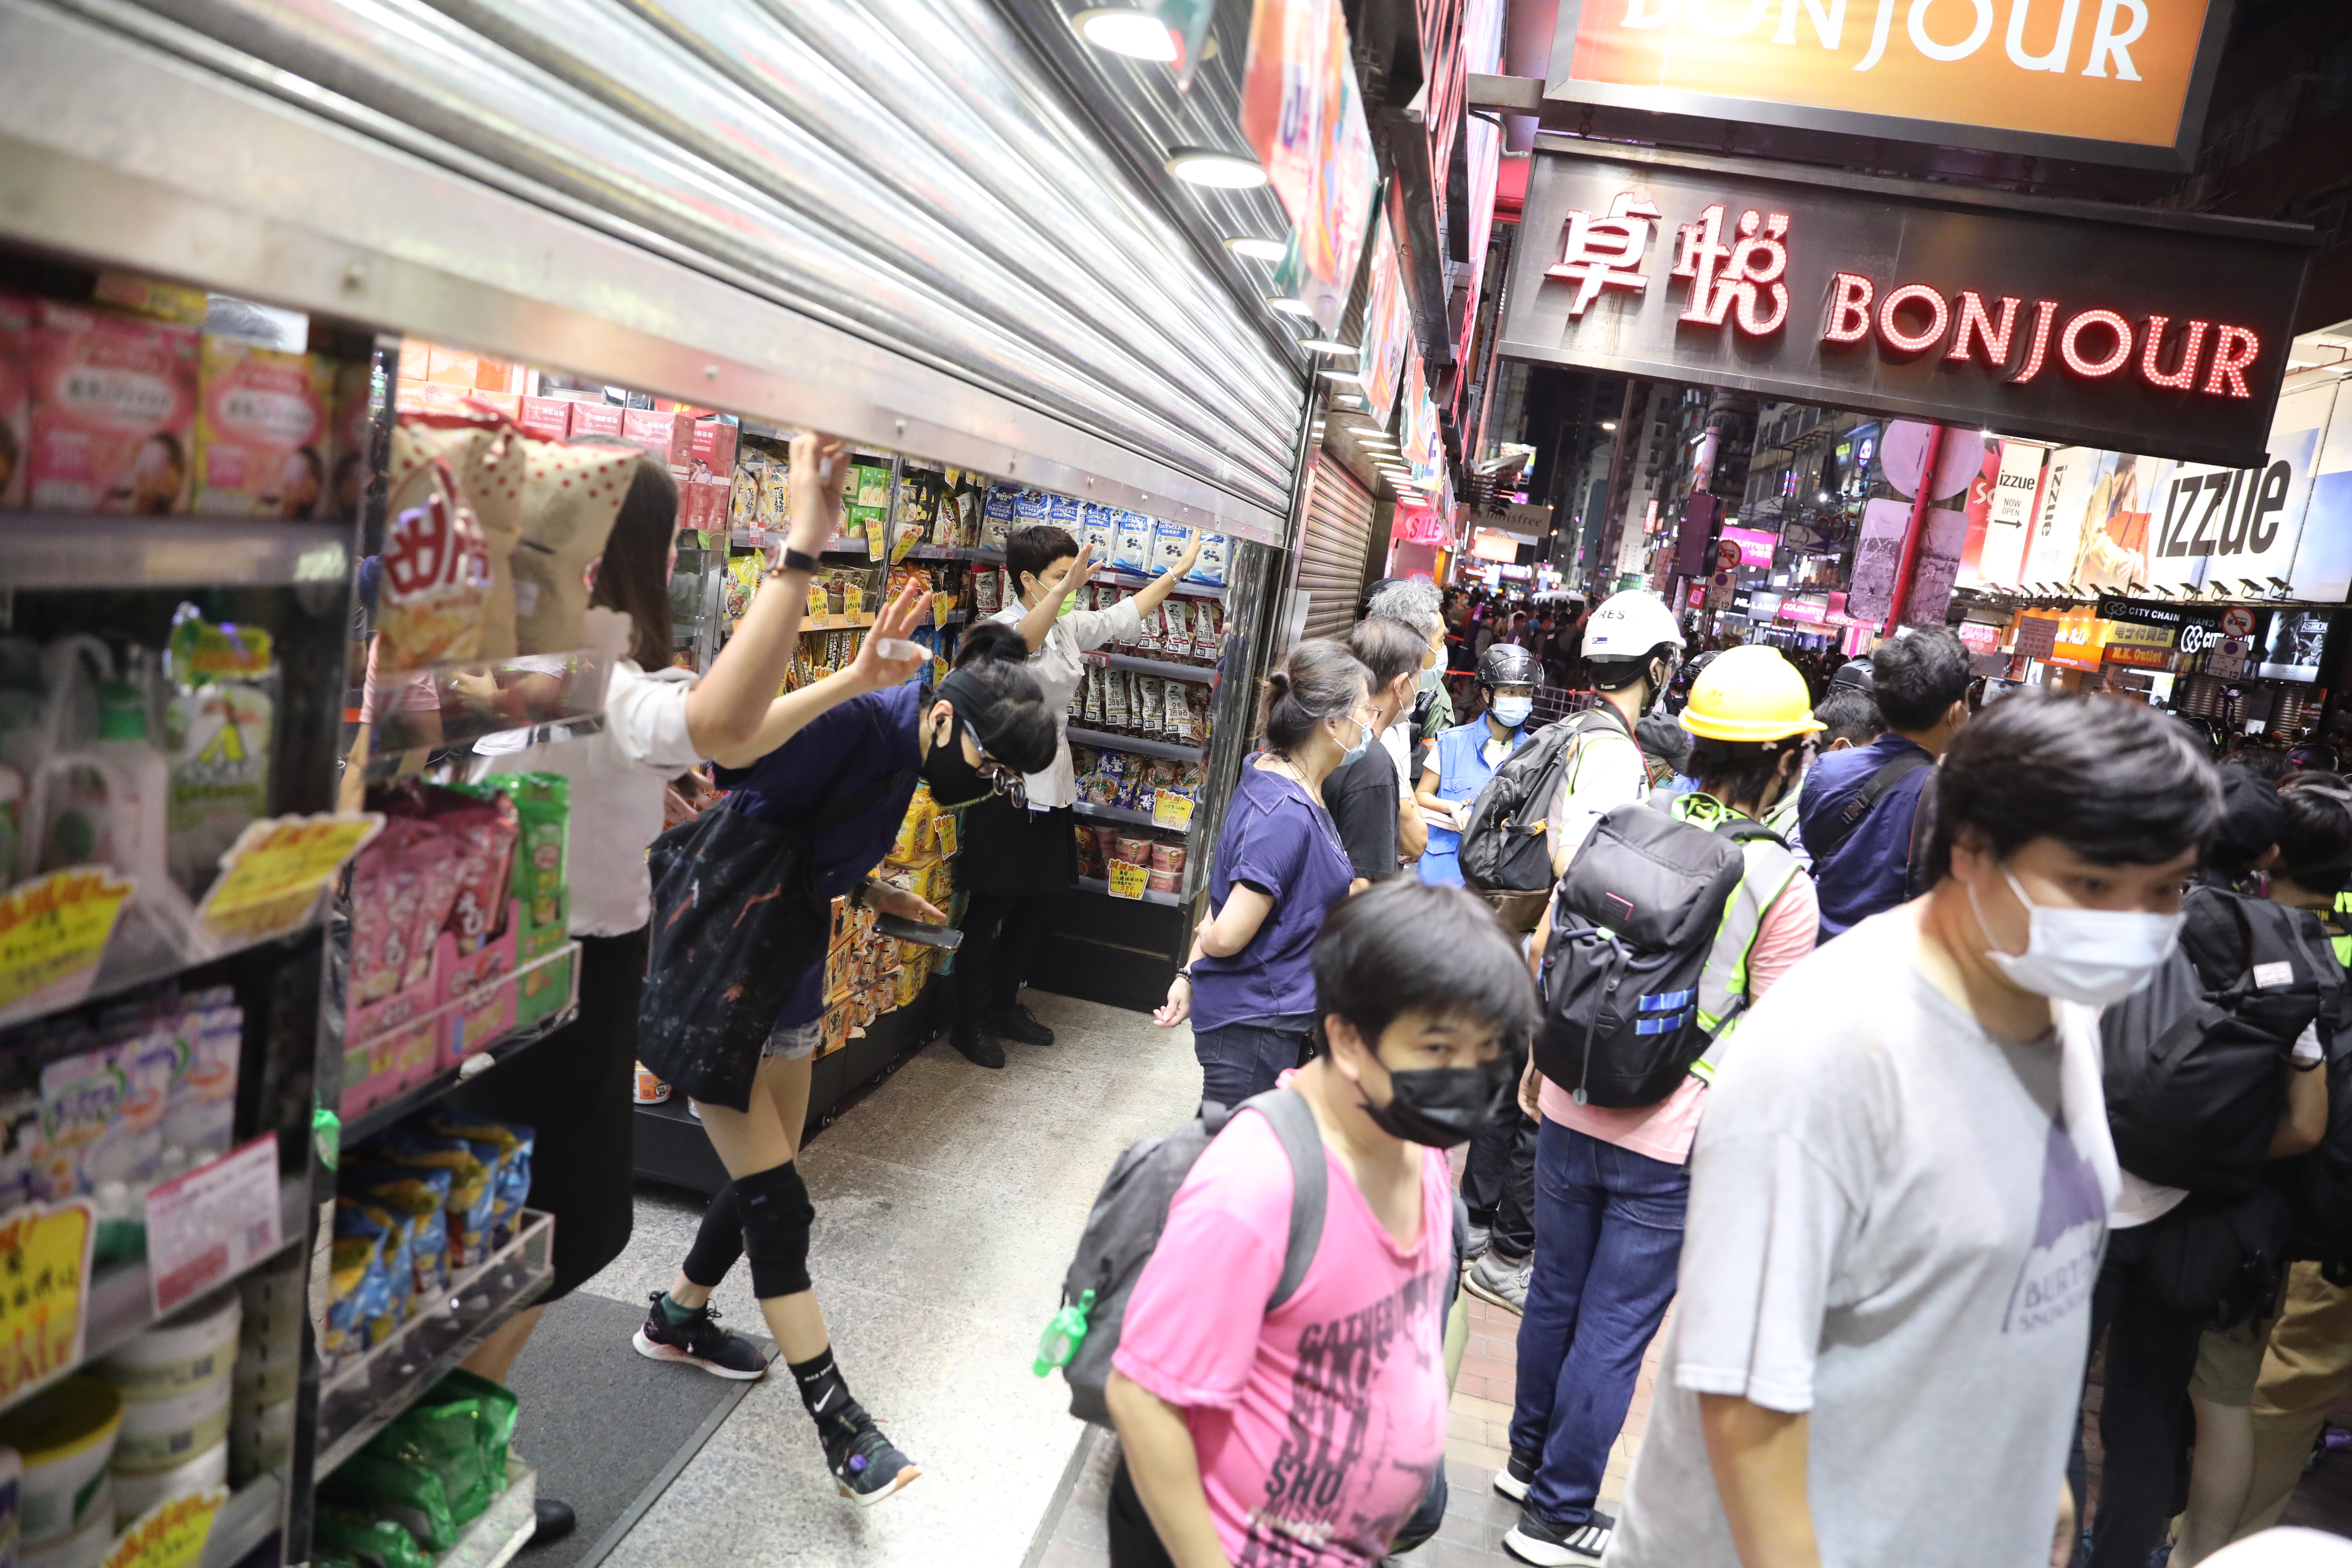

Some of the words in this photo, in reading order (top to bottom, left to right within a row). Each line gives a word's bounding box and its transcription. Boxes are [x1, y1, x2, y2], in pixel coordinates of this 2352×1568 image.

[1544, 192, 1789, 336] 卓悅
[1823, 271, 2260, 399] BONJOUR
[1999, 469, 2035, 490] izzue
[775, 486, 785, 514] 函館
[2004, 498, 2022, 508] NOW
[2042, 465, 2067, 536] izzue
[2002, 507, 2020, 516] OPEN
[2155, 460, 2291, 557] izzue
[1409, 516, 1439, 538] SALE
[2129, 607, 2151, 618] CITY
[2151, 610, 2180, 622] CHAIN
[2301, 622, 2328, 631] ASTRON
[2050, 656, 2078, 666] mannings
[2134, 649, 2162, 663] Outlet
[1155, 790, 1184, 802] 減減減!
[948, 845, 956, 855] SALE
[1109, 860, 1138, 872] 減減減!
[804, 1373, 820, 1382] MAX
